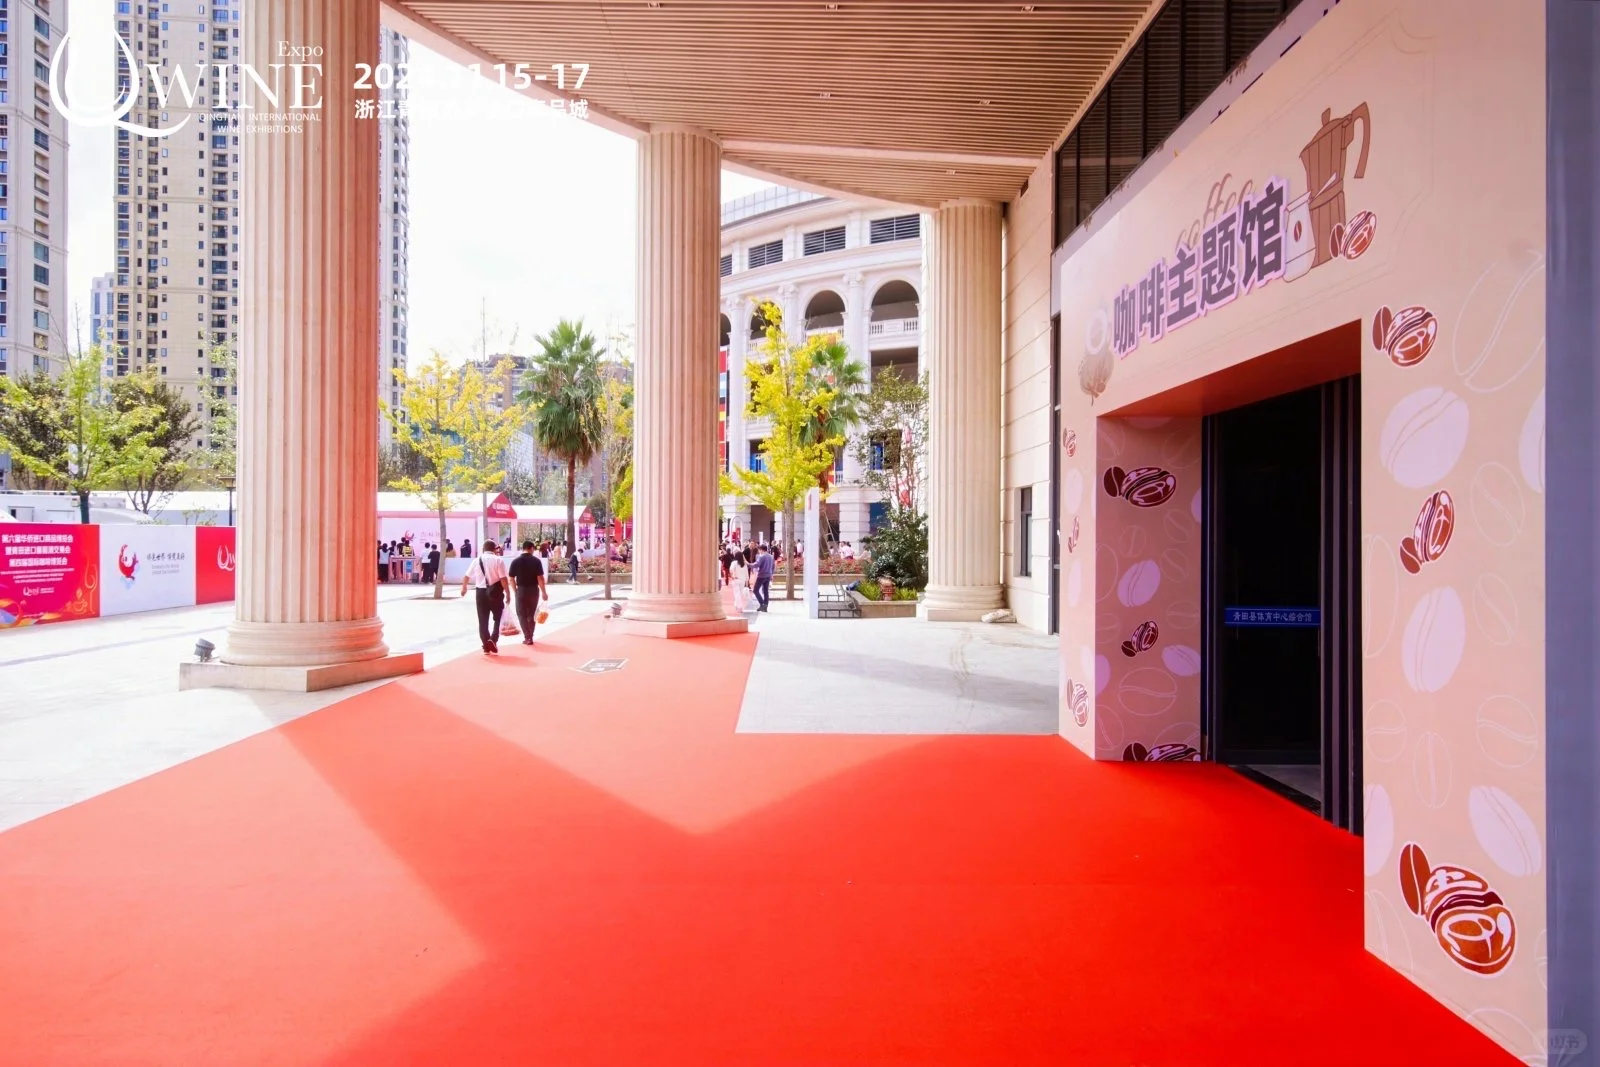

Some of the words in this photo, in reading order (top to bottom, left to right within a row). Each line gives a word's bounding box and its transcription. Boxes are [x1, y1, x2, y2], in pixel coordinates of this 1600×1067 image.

[1112, 178, 1288, 356] 咖啡主题馆
[1232, 611, 1313, 622] 青田县体育中心综合馆
